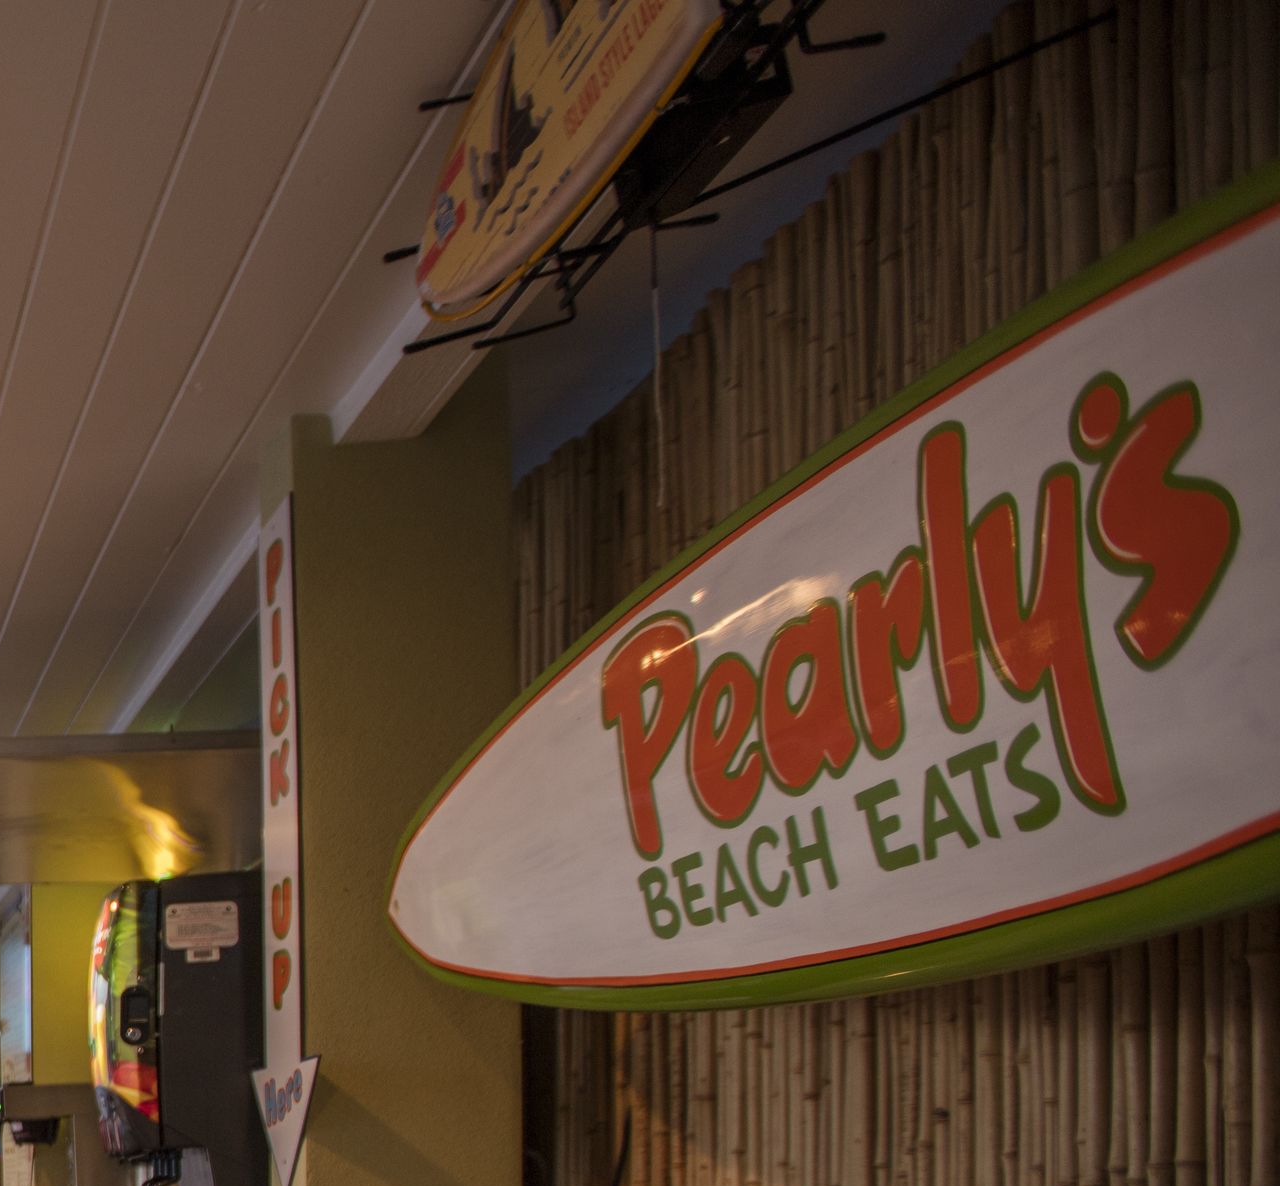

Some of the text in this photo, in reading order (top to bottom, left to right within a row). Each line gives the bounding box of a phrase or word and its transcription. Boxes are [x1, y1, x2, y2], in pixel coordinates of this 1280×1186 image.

[564, 73, 602, 137] ISLAND
[600, 24, 635, 87] STYLE
[602, 371, 1240, 862] Pearly's
[266, 538, 293, 1011] PICK UP
[638, 722, 1062, 940] BEACH EATS
[264, 1064, 304, 1130] Here
